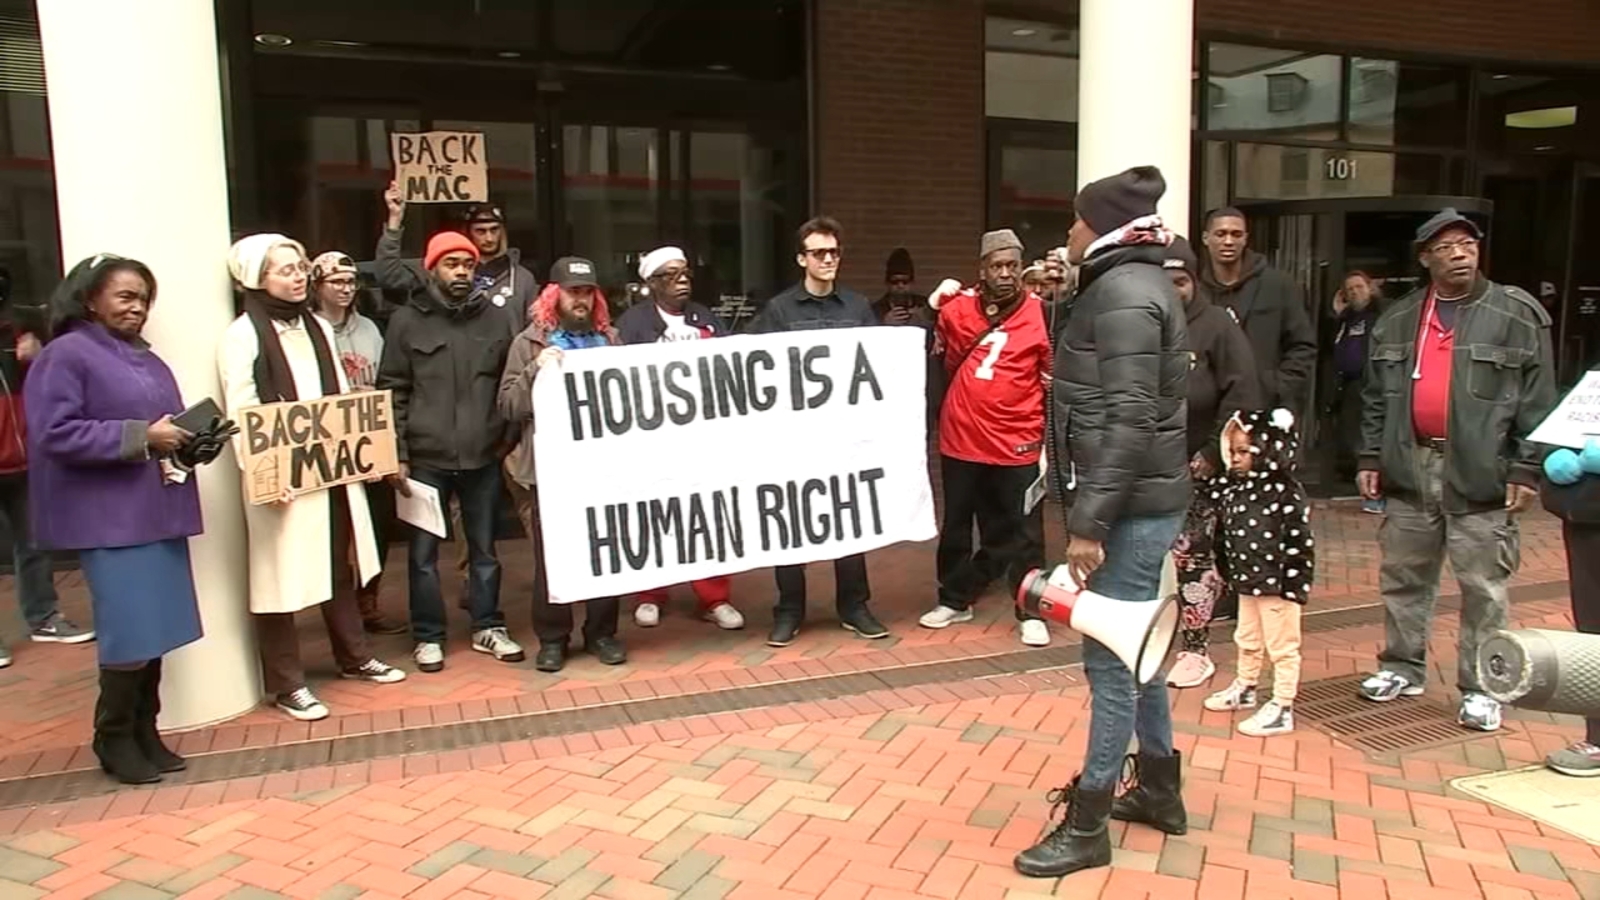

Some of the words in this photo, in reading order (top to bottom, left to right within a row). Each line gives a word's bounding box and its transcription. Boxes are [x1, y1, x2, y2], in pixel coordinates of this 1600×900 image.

[399, 135, 477, 164] BACK
[427, 164, 452, 175] THE
[1327, 158, 1356, 179] 101
[407, 175, 471, 200] MAC
[974, 330, 1009, 380] 7
[564, 350, 777, 441] HOUSING
[787, 345, 833, 411] IS
[848, 341, 884, 405] A
[246, 402, 332, 455] BACK
[336, 394, 387, 434] THE
[291, 436, 374, 488] MAC
[586, 486, 744, 577] HUMAN
[756, 467, 884, 551] RIGHT
